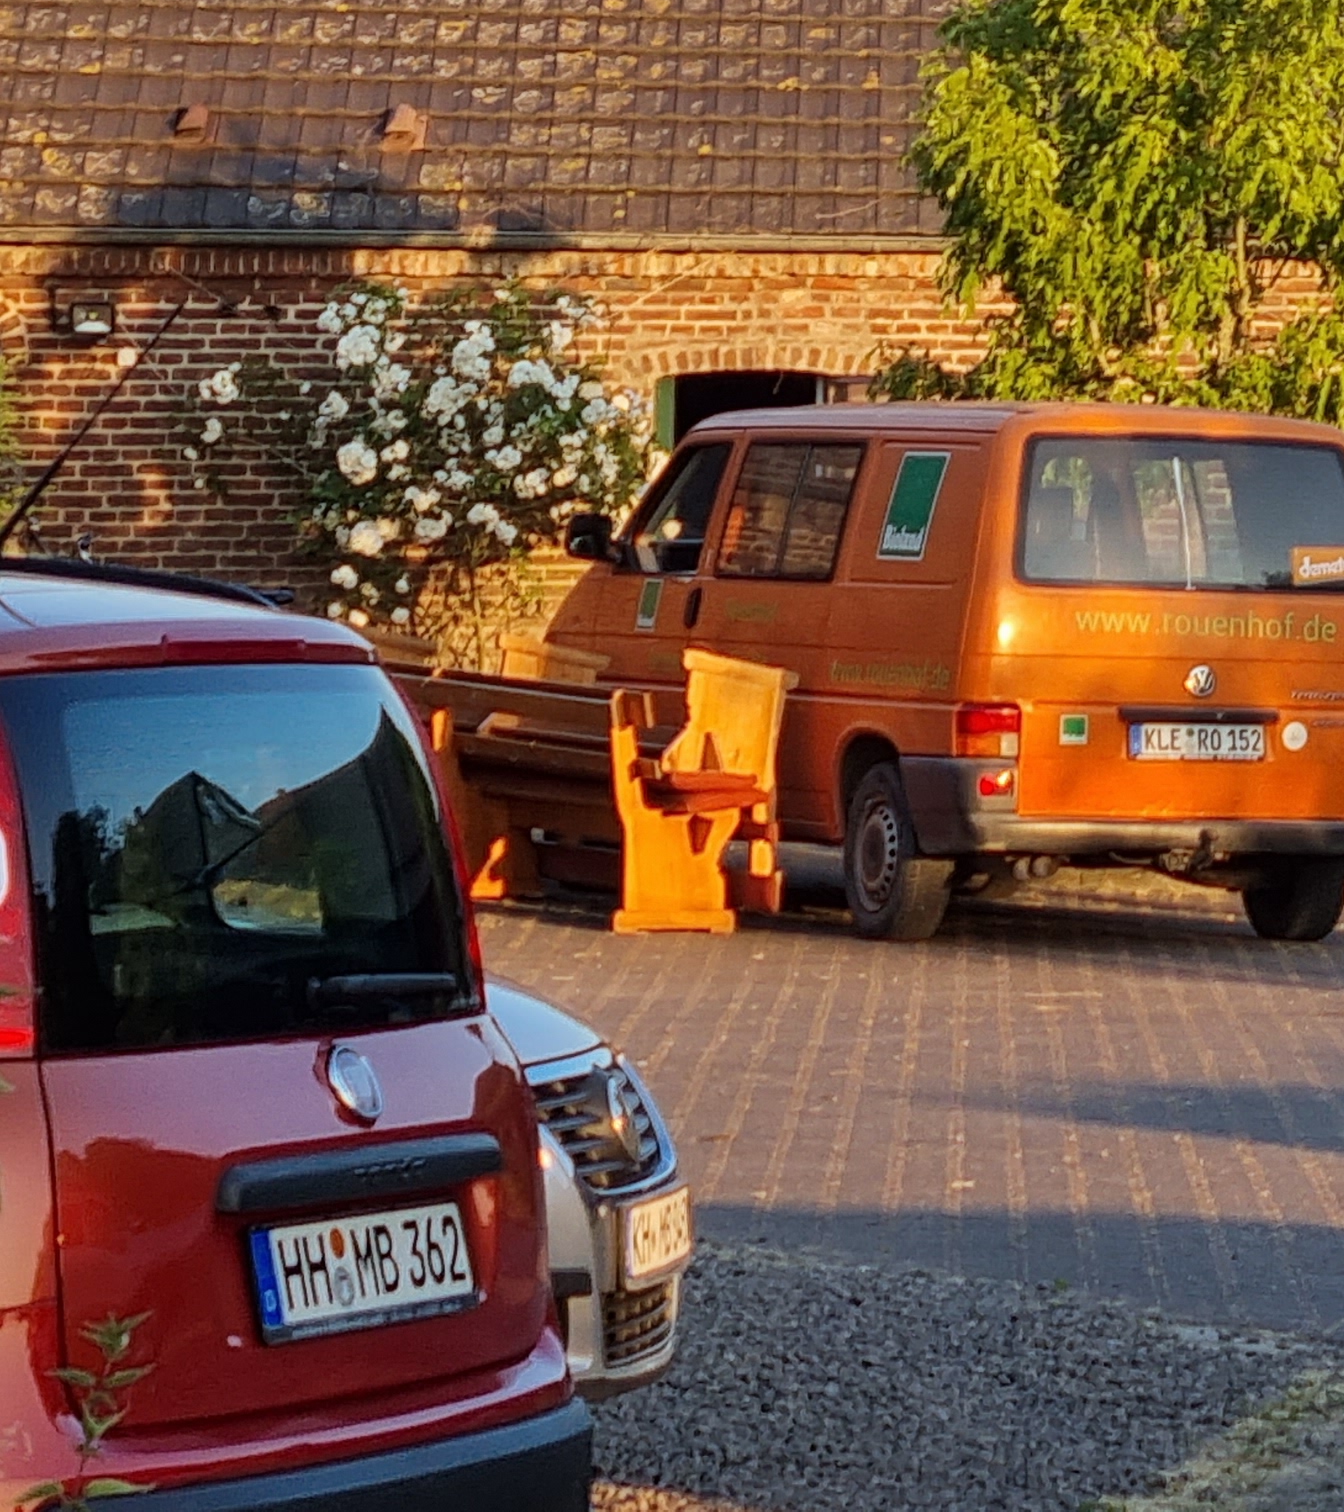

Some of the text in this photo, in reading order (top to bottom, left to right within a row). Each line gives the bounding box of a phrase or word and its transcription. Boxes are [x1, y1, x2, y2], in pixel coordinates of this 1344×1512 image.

[1075, 609, 1338, 643] www.rouenhof.de
[1144, 727, 1262, 753] KLE RO 152
[278, 1216, 466, 1311] HH MB 362
